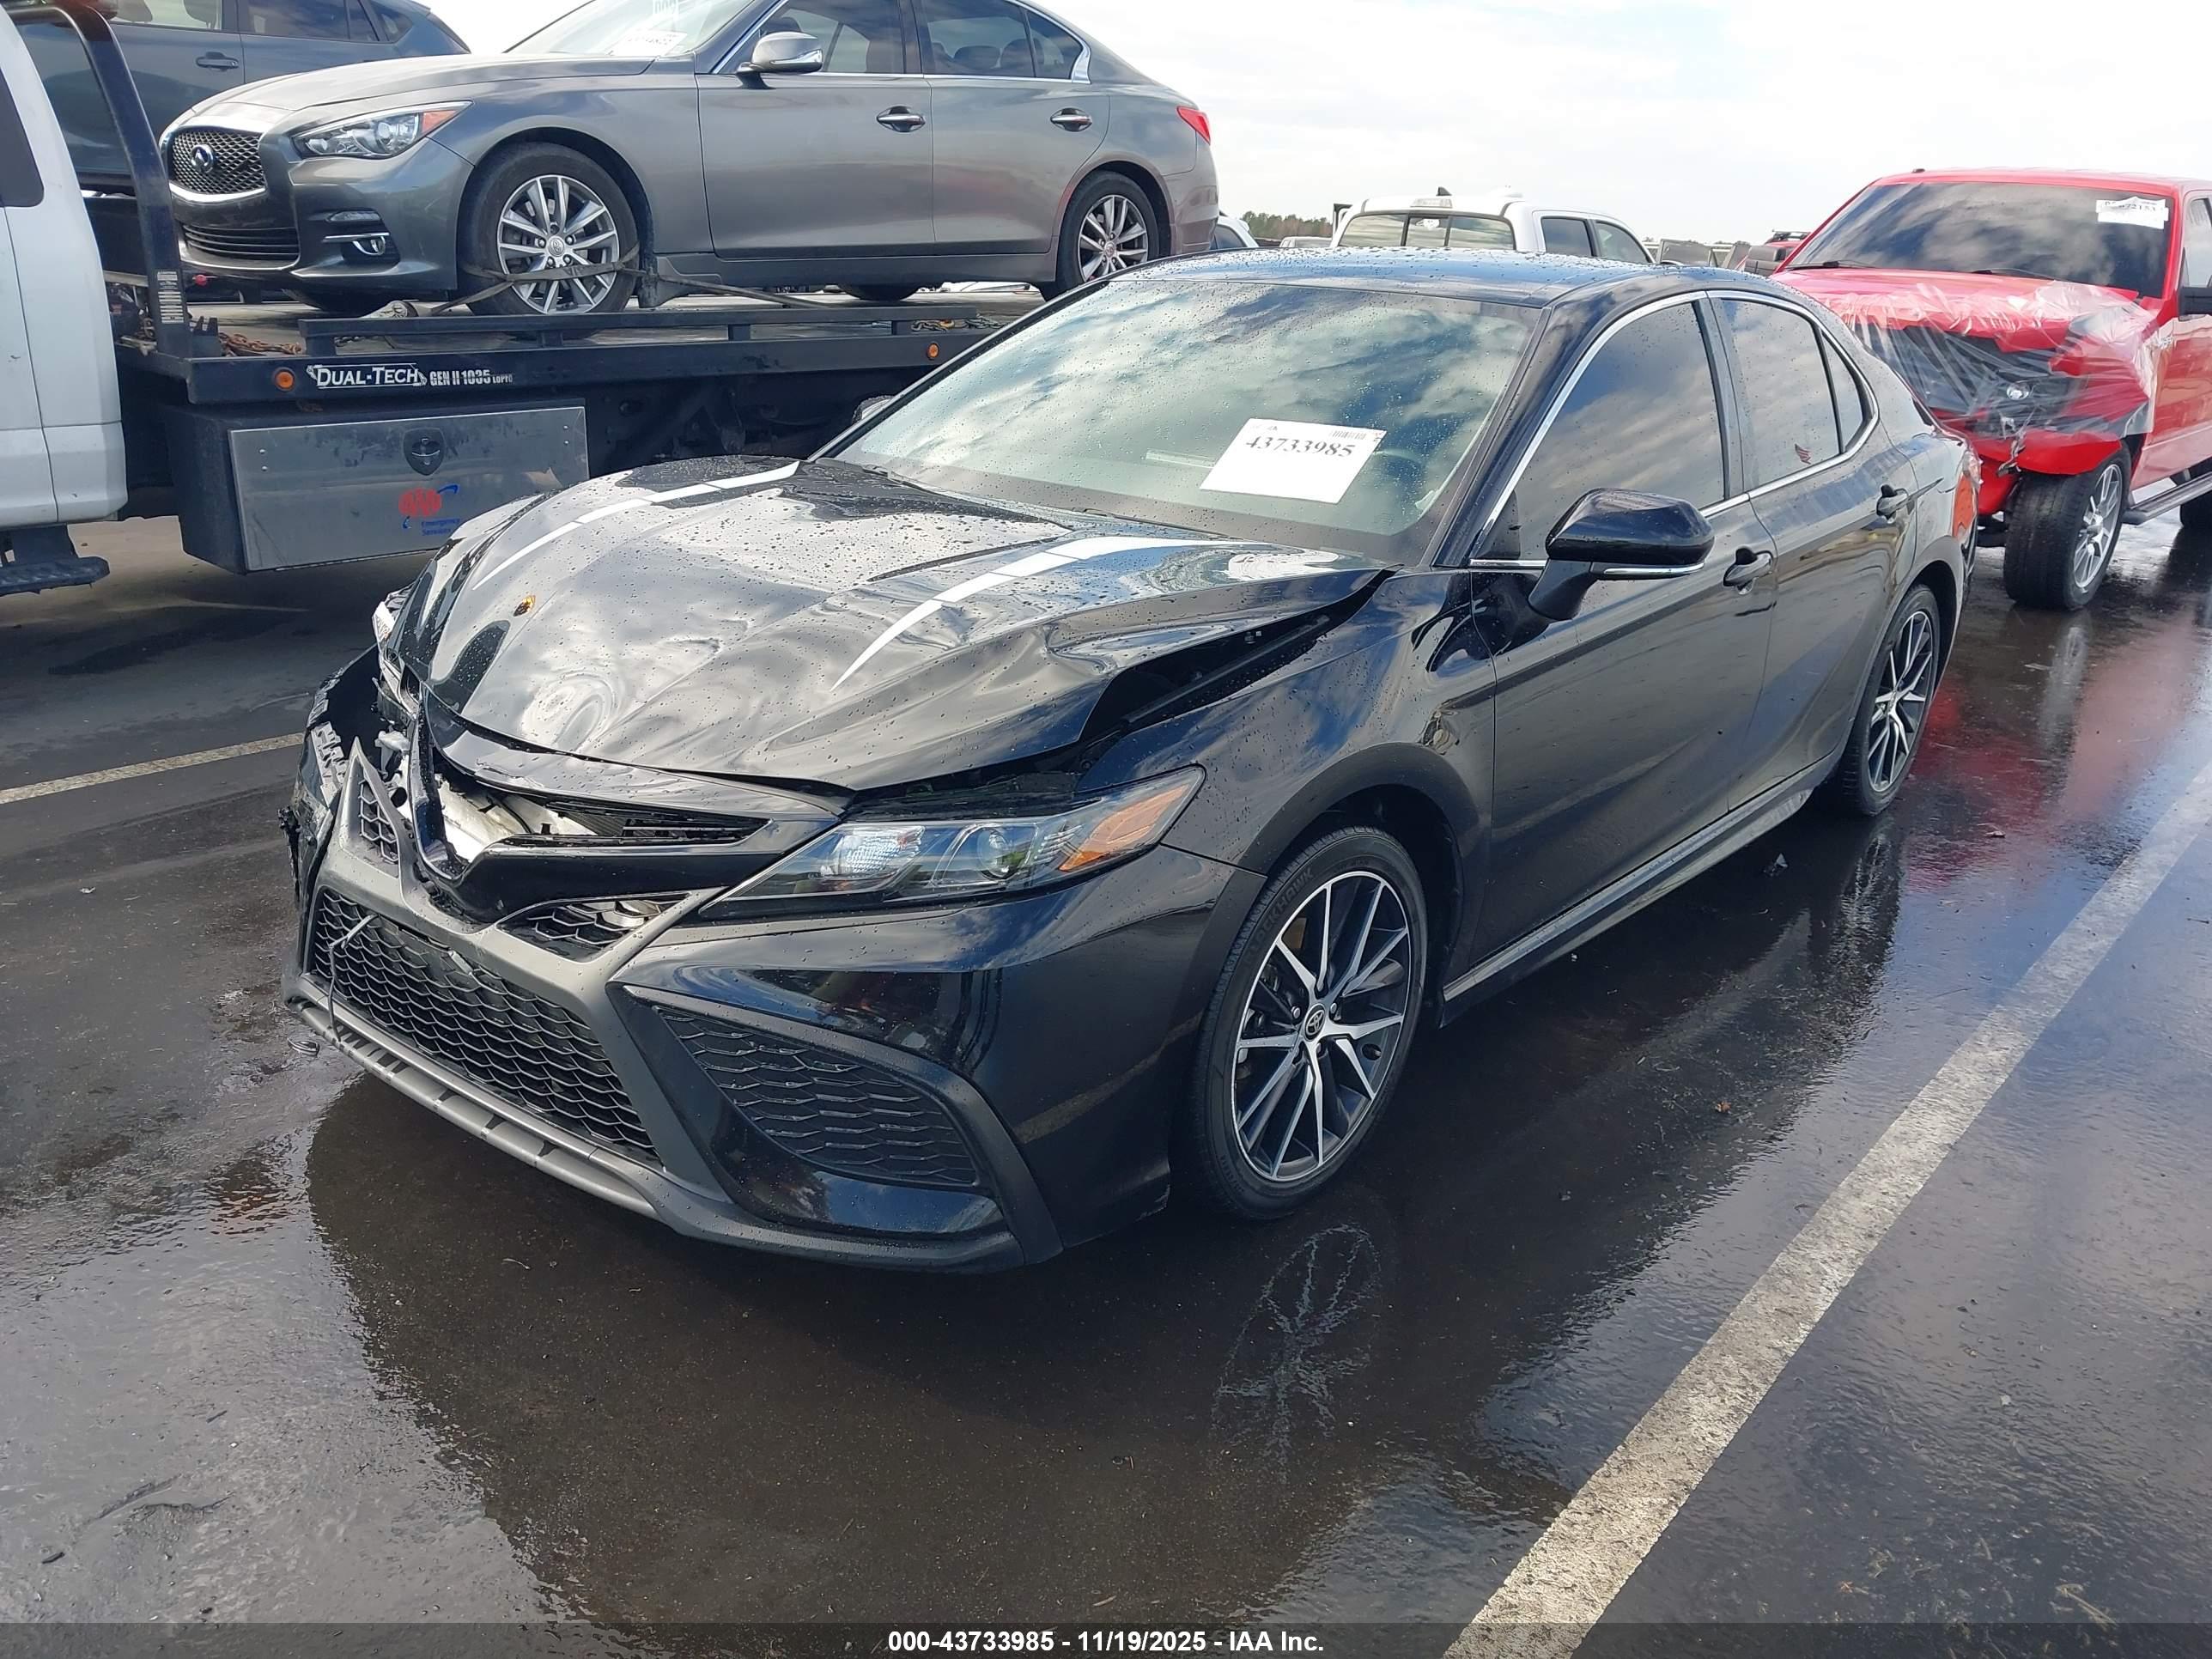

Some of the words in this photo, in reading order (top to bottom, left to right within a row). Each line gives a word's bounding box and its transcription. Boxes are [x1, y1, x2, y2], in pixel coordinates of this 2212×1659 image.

[429, 371, 451, 386] GEN
[461, 369, 491, 386] 1035
[1245, 435, 1356, 458] 43733985
